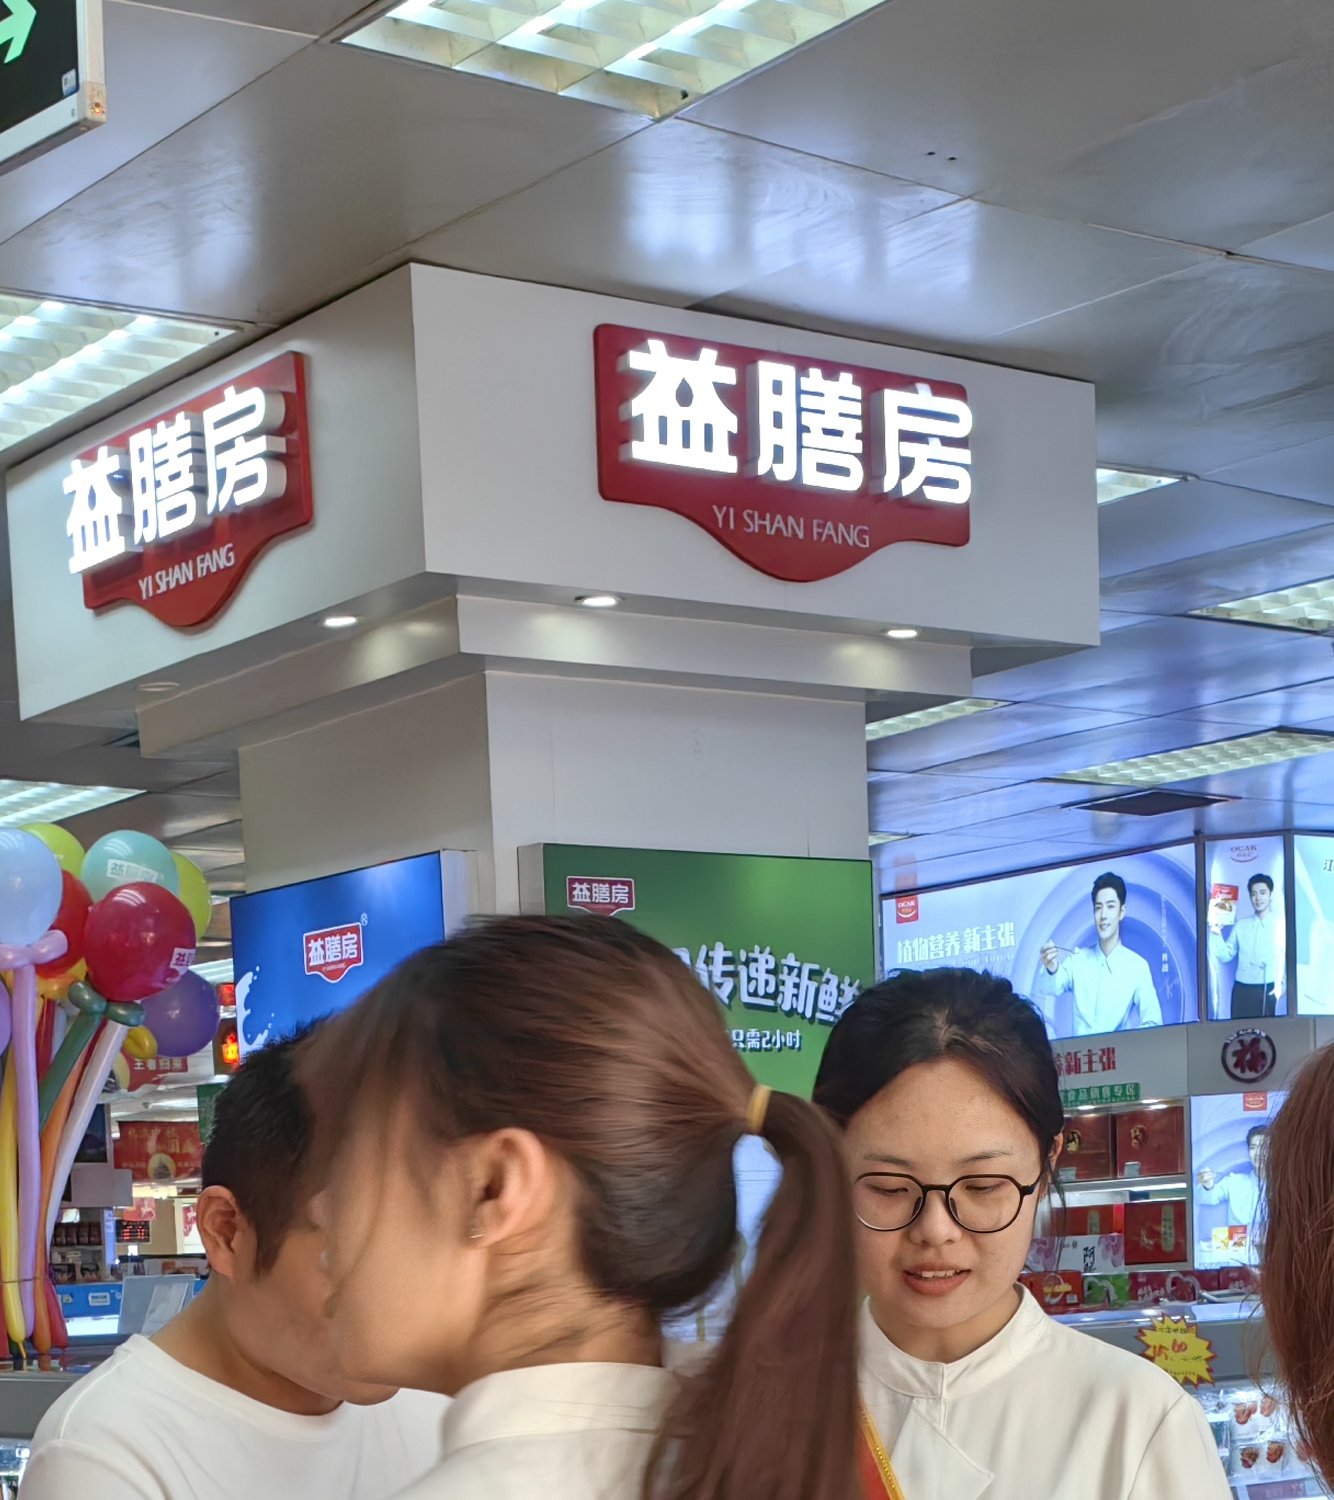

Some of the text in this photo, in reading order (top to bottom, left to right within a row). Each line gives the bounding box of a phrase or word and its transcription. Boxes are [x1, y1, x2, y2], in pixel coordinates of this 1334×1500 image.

[629, 339, 972, 504] 益膳房
[63, 386, 267, 575] 益膳房
[712, 505, 870, 548] YI SHAN FANG
[138, 543, 236, 600] YI SHAN FANG
[572, 882, 629, 904] 益膳房
[308, 932, 357, 966] 益膳房
[671, 942, 861, 1023] 传递新鲜
[731, 1029, 802, 1050] 只需2小时
